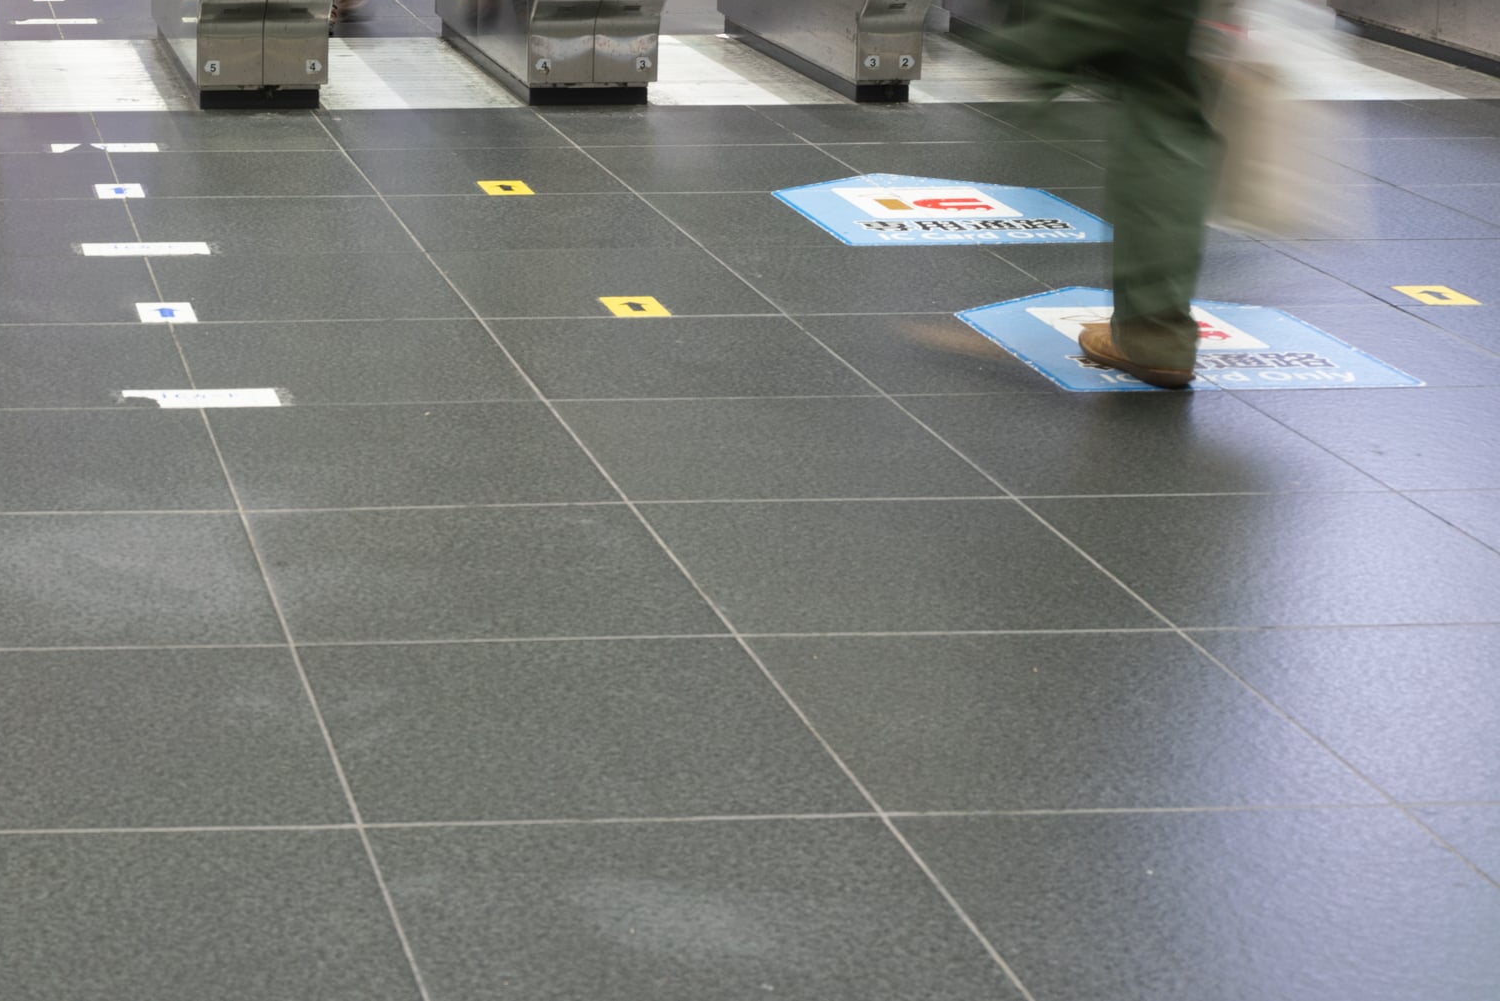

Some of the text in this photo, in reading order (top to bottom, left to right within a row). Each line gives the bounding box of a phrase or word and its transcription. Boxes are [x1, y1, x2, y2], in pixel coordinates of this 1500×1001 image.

[208, 61, 318, 75] 5 4
[638, 57, 647, 69] 3
[868, 57, 910, 68] 3 2
[857, 217, 1076, 231] 専用通路
[877, 231, 1087, 241] IC Card Only
[1257, 368, 1357, 382] Only
